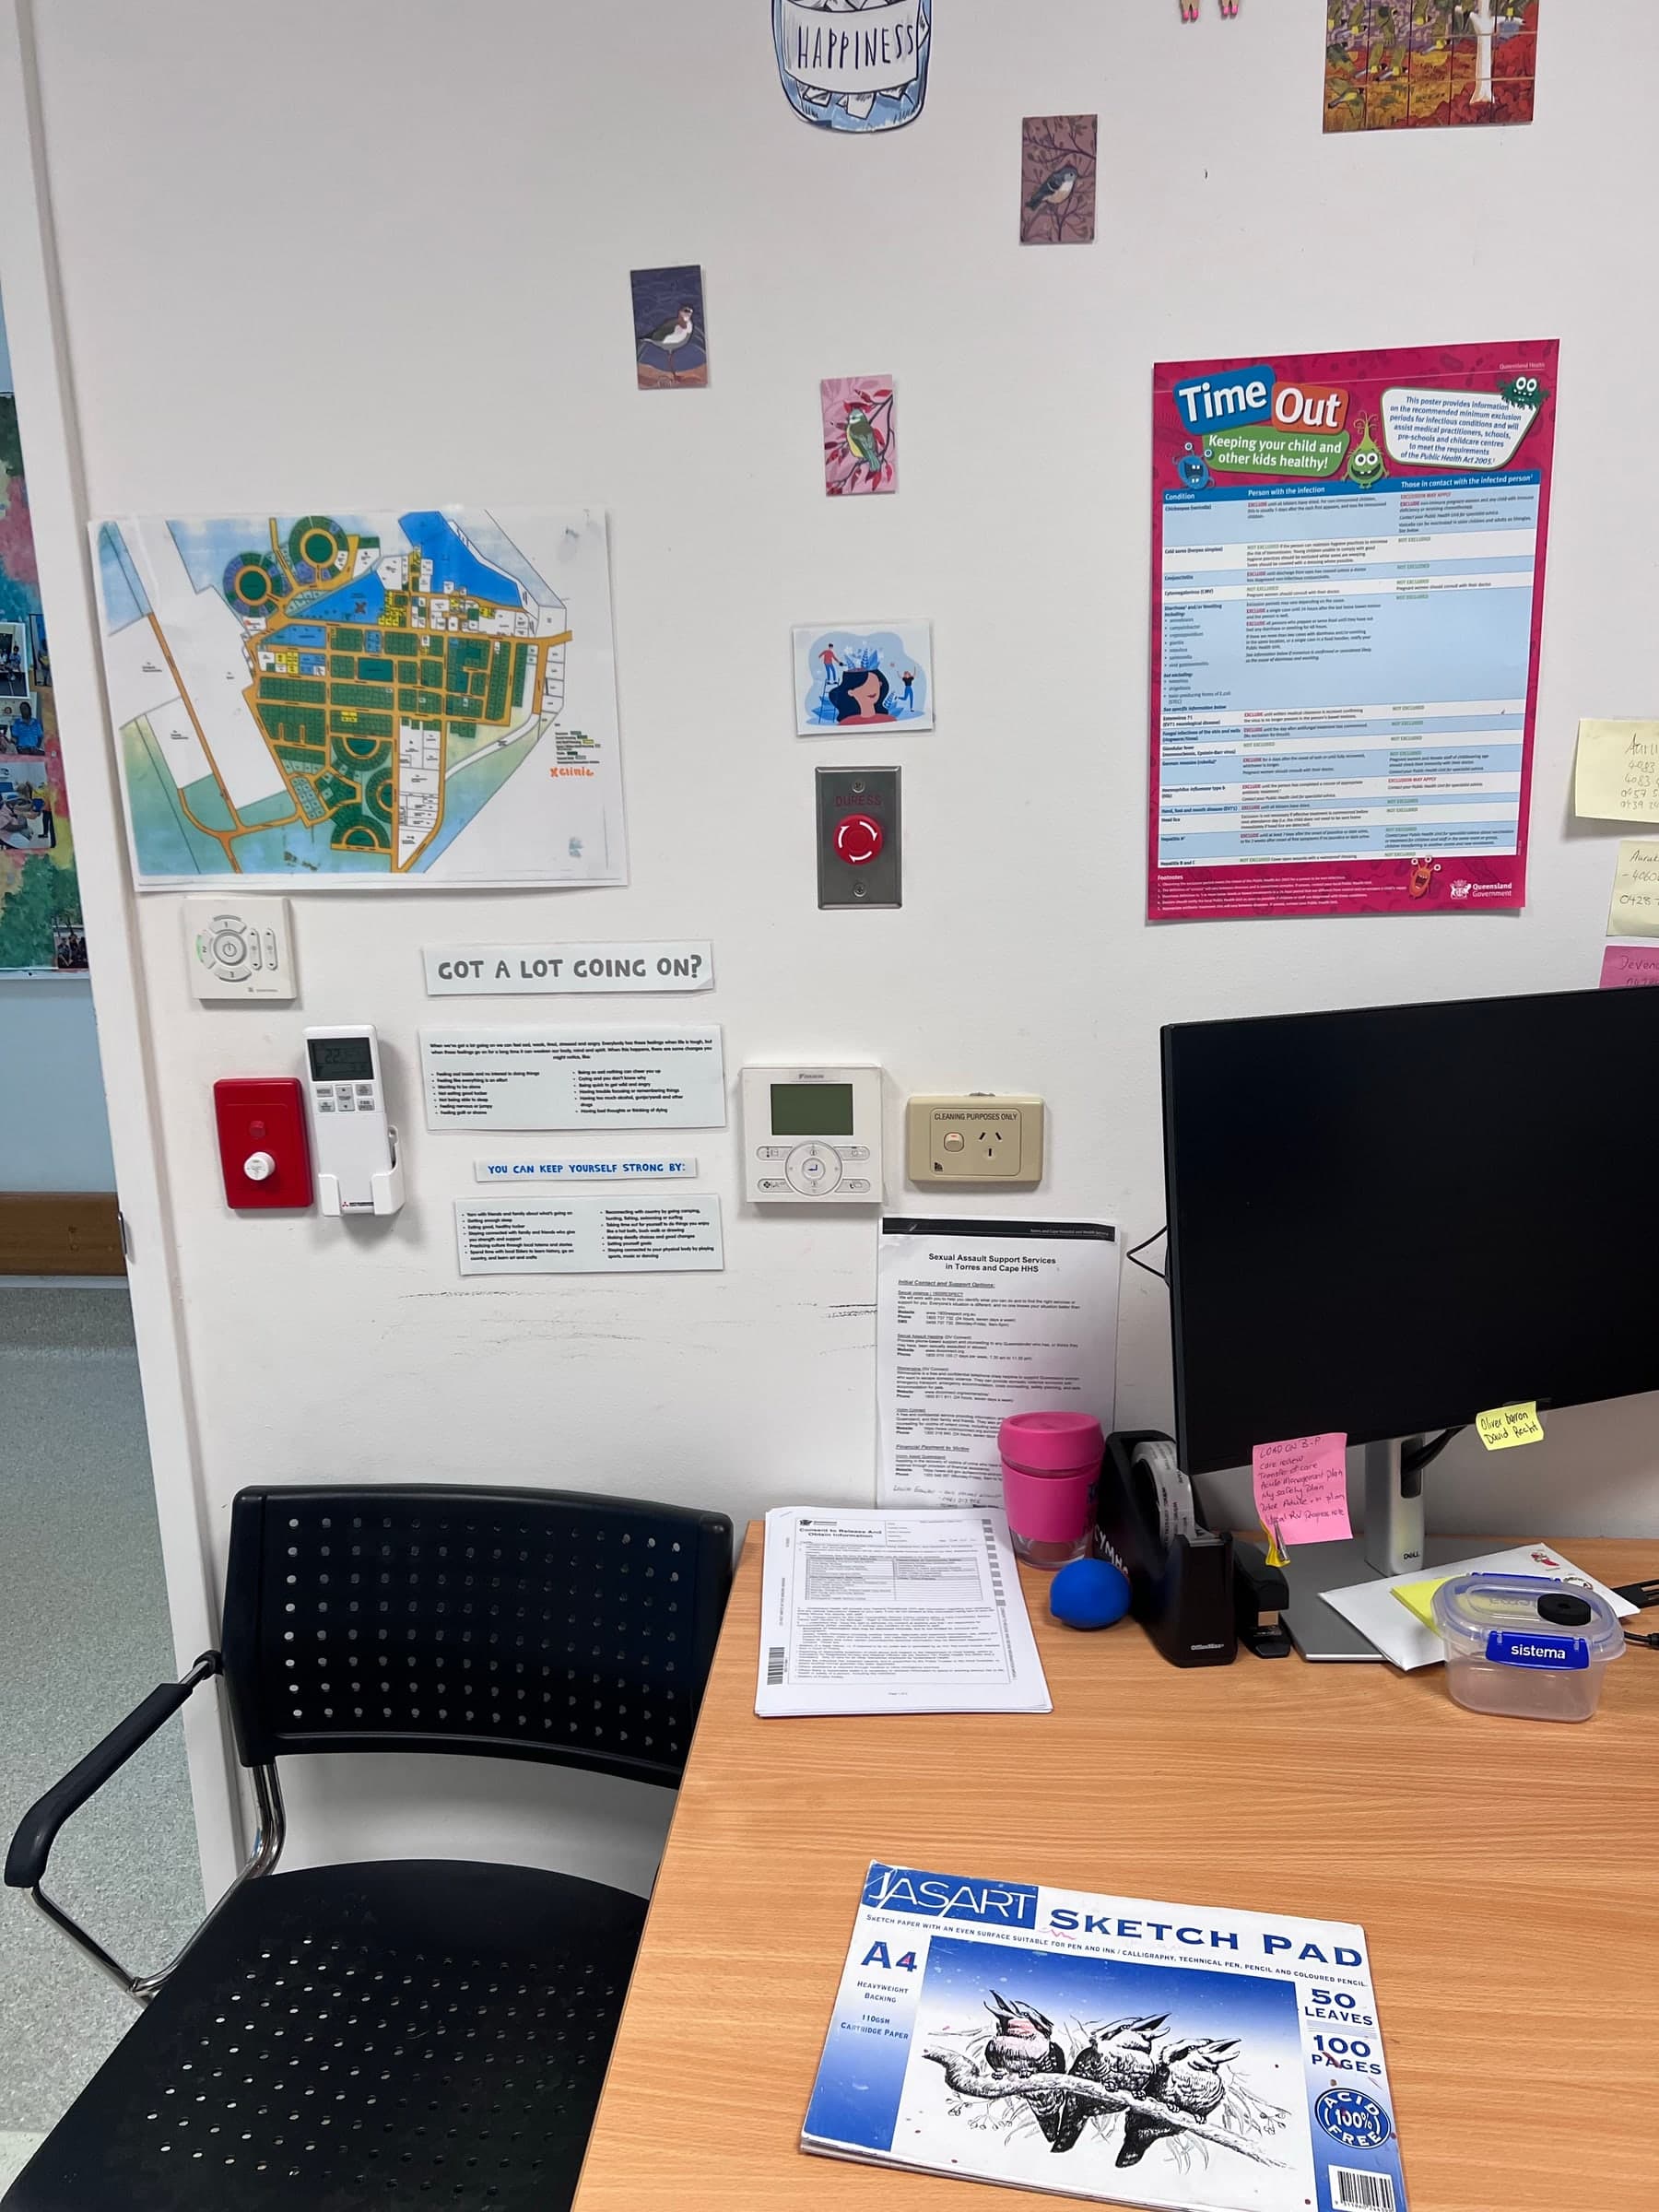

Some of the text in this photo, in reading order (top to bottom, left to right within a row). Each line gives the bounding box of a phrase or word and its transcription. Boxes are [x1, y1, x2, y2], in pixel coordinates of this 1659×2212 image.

[797, 24, 914, 70] HAPPINESS
[1179, 381, 1268, 422] Time
[1275, 387, 1342, 428] Out
[1420, 397, 1441, 406] poster
[1442, 399, 1471, 408] provides
[1472, 401, 1510, 411] information
[1412, 407, 1458, 416] recommended
[1459, 410, 1490, 418] minimum
[1491, 411, 1522, 421] exclusion
[1390, 415, 1415, 423] periods
[1415, 416, 1425, 424] for
[1426, 417, 1458, 426] infectious
[1459, 418, 1493, 429] conditions
[1507, 422, 1519, 430] will
[1398, 433, 1435, 442] pre-schools
[1450, 436, 1480, 445] childcare
[1480, 439, 1504, 447] centres
[1414, 425, 1440, 433] medical
[1441, 427, 1483, 437] practitioners,
[1485, 430, 1512, 440] schools,
[1208, 434, 1342, 453] Keeping your child and
[1435, 443, 1446, 452] the
[1447, 446, 1489, 455] requirements
[1218, 453, 1328, 472] other kids healthy!
[1420, 453, 1441, 462] Public
[1441, 453, 1462, 463] Health
[1401, 480, 1420, 488] Those
[1429, 478, 1453, 487] contact
[1453, 477, 1467, 486] with
[1468, 477, 1479, 485] the
[1480, 476, 1507, 485] infected
[1165, 492, 1195, 501] Condition
[1248, 486, 1325, 497] Person with the infection
[1473, 882, 1512, 890] Queensland
[438, 955, 702, 980] GOT A LOT GOING ON?
[488, 1162, 687, 1174] YOU CAN KEEP YOURSELF STRONG BY:
[929, 1253, 1056, 1265] Sexual Assault Support Services
[954, 1264, 981, 1272] Torres
[982, 1264, 997, 1272] and
[999, 1265, 1019, 1274] Cape
[1484, 1428, 1509, 1444] David
[1404, 1551, 1420, 1559] DELL
[1511, 1643, 1566, 1660] sistema
[869, 1872, 1036, 1920] JASART
[1050, 1909, 1363, 1967] SKETCH PAD
[861, 1940, 918, 1972] A4
[867, 1914, 895, 1924] SKETCH
[897, 1919, 921, 1928] PAPER
[923, 1922, 941, 1931] WITH
[956, 1926, 975, 1936] EVEN
[977, 1929, 1010, 1940] SURFACE
[1012, 1935, 1049, 1947] SUITABLE
[1102, 1947, 1115, 1955] INK
[1123, 1950, 1177, 1962] CALLIGRAPHY,
[1179, 1956, 1222, 1967] TECHNICAL
[1225, 1961, 1242, 1970] PEN,
[1245, 1964, 1273, 1973] PENCIL
[1276, 1968, 1291, 1976] AND
[1294, 1971, 1335, 1983] COLOURED
[857, 1981, 909, 1994] HEAVYWEIGHT
[865, 1993, 897, 2003] BACKING
[1311, 1988, 1357, 2009] 50
[862, 2014, 890, 2025] 110GSM
[1304, 2006, 1373, 2026] LEAVES
[841, 2022, 909, 2040] CARTRIDGE PAPER
[1313, 2034, 1371, 2058] 100
[1311, 2053, 1382, 2075] PAGES
[1324, 2092, 1380, 2117] ACID
[1335, 2109, 1373, 2130] 100%
[1327, 2125, 1382, 2147] FREE
